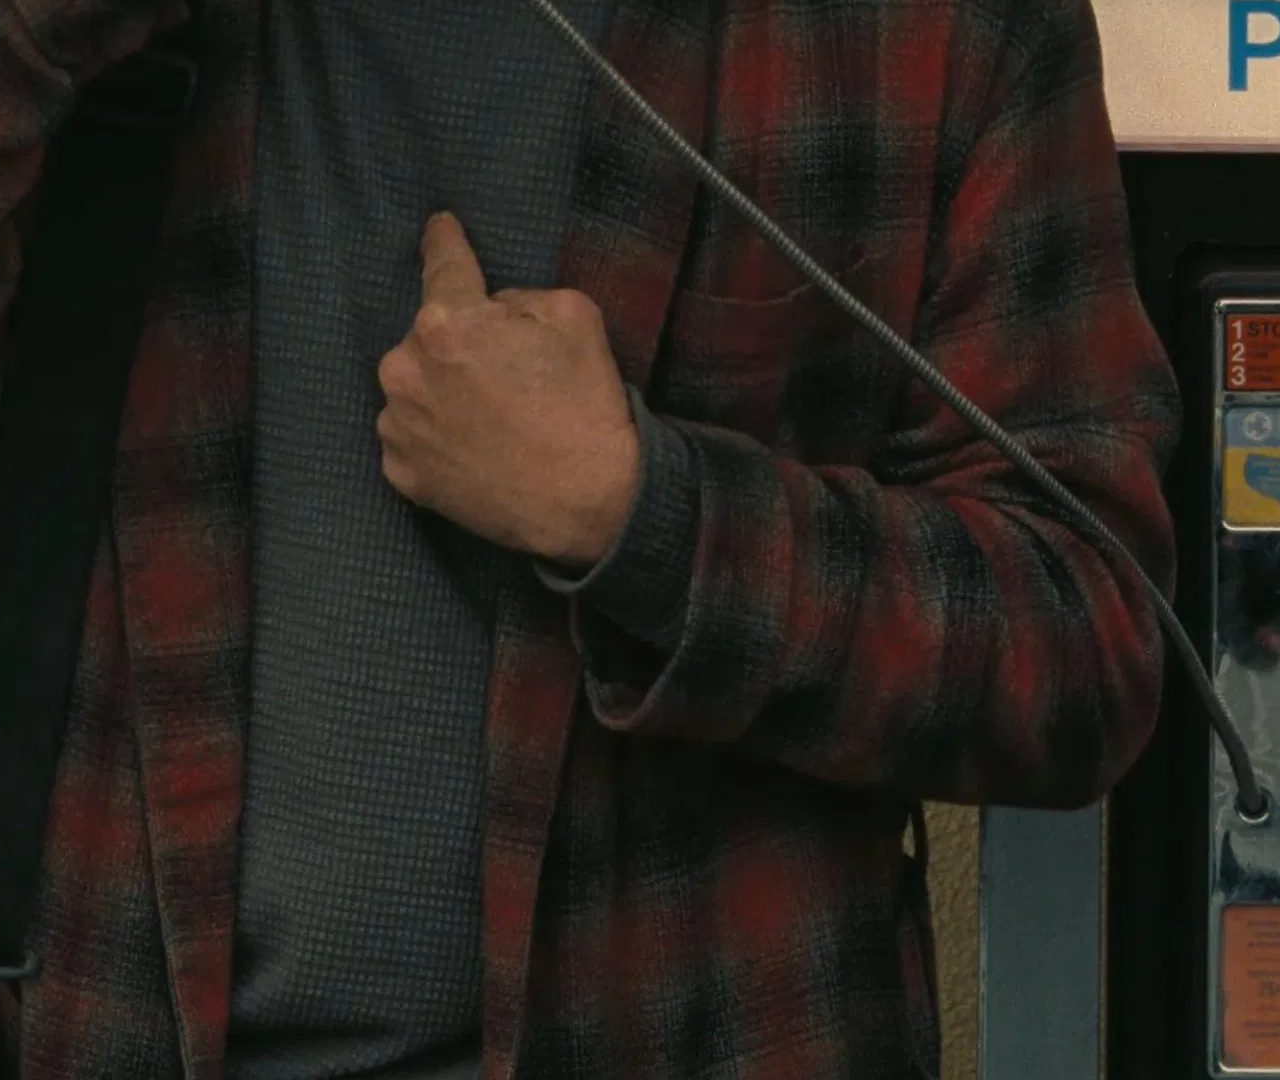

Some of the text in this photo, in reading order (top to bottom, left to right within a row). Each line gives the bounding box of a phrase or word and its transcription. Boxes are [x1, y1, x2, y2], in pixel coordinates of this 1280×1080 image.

[1231, 320, 1243, 340] 1
[1231, 342, 1245, 362] 2
[1231, 365, 1246, 386] 3
